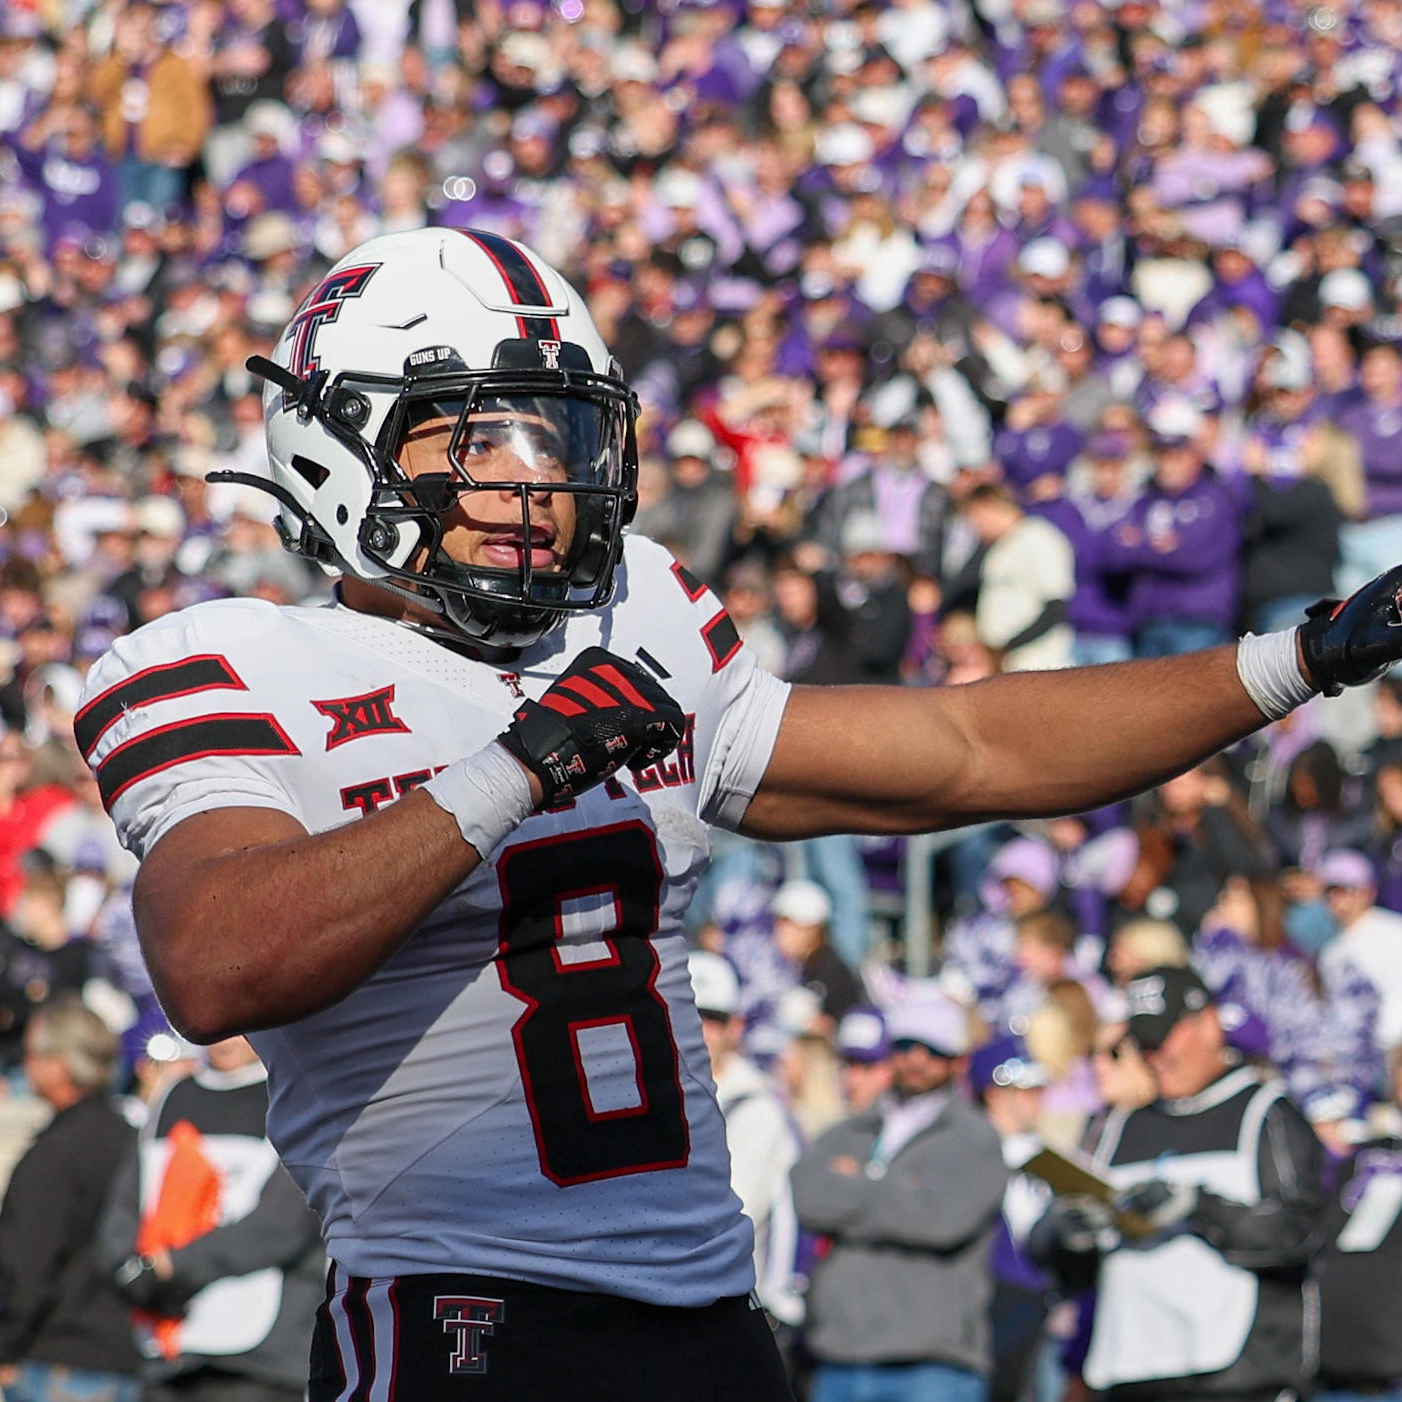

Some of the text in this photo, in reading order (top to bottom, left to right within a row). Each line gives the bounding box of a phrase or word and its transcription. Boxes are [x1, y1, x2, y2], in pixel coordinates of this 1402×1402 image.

[409, 348, 451, 366] GUNS UP
[498, 819, 690, 1187] 8
